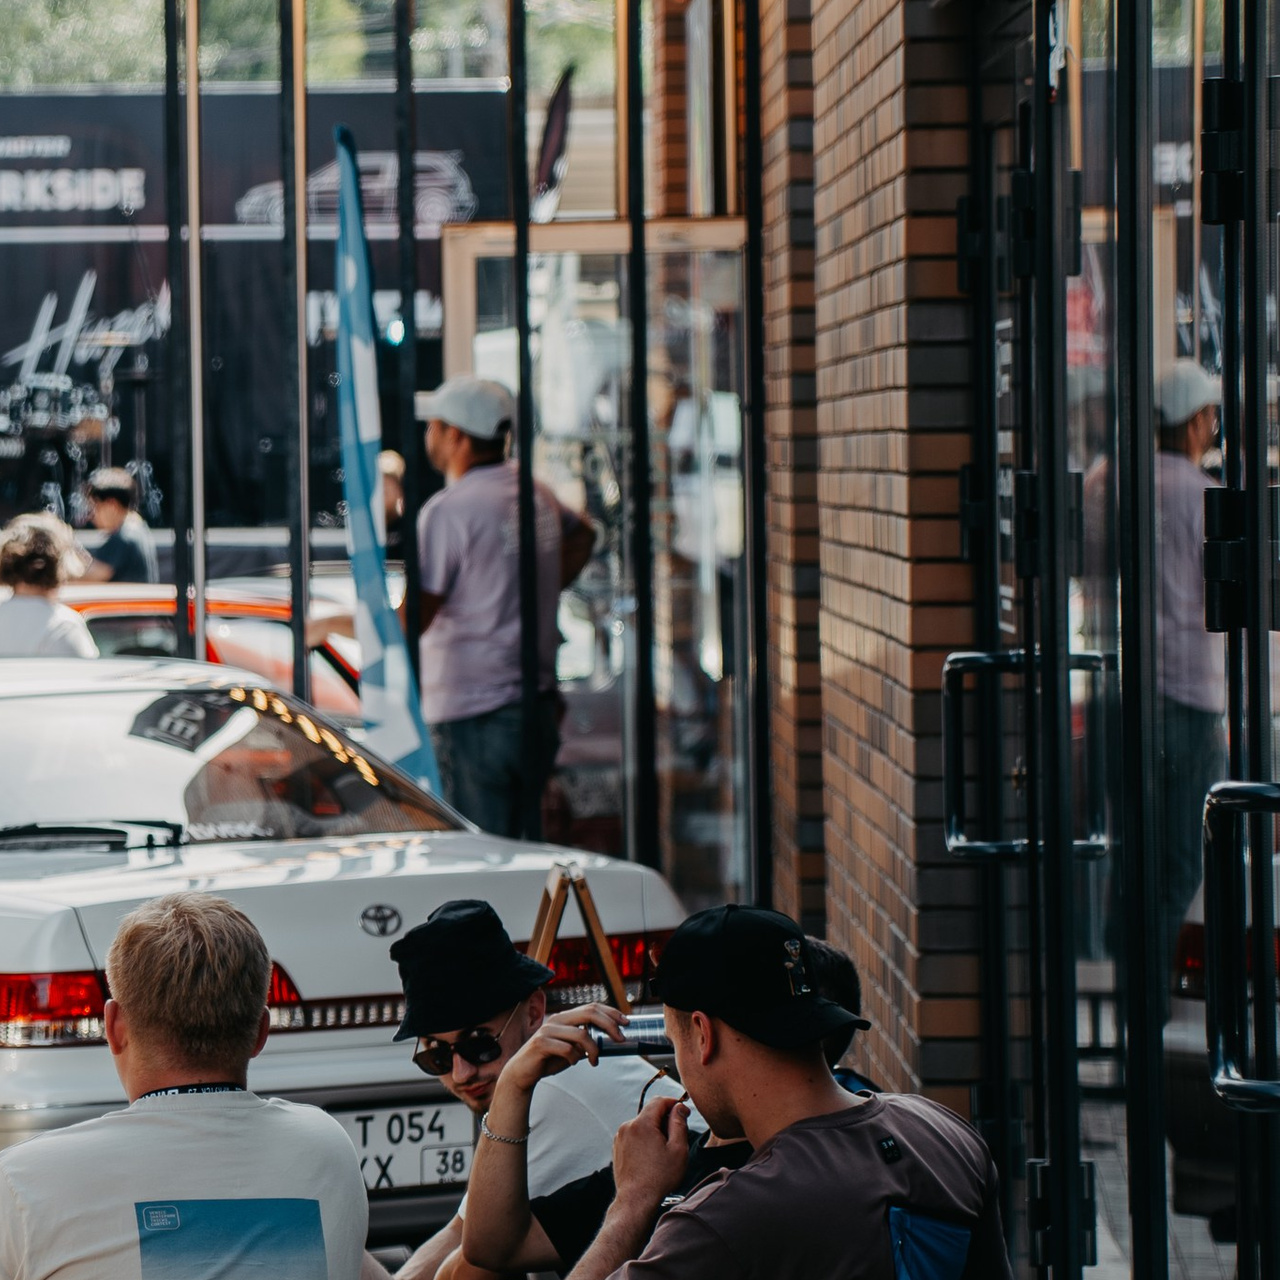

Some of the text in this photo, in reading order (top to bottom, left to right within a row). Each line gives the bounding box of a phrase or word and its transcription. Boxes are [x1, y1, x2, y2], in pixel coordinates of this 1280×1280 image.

[355, 1108, 445, 1148] T 054
[436, 1150, 464, 1175] 38
